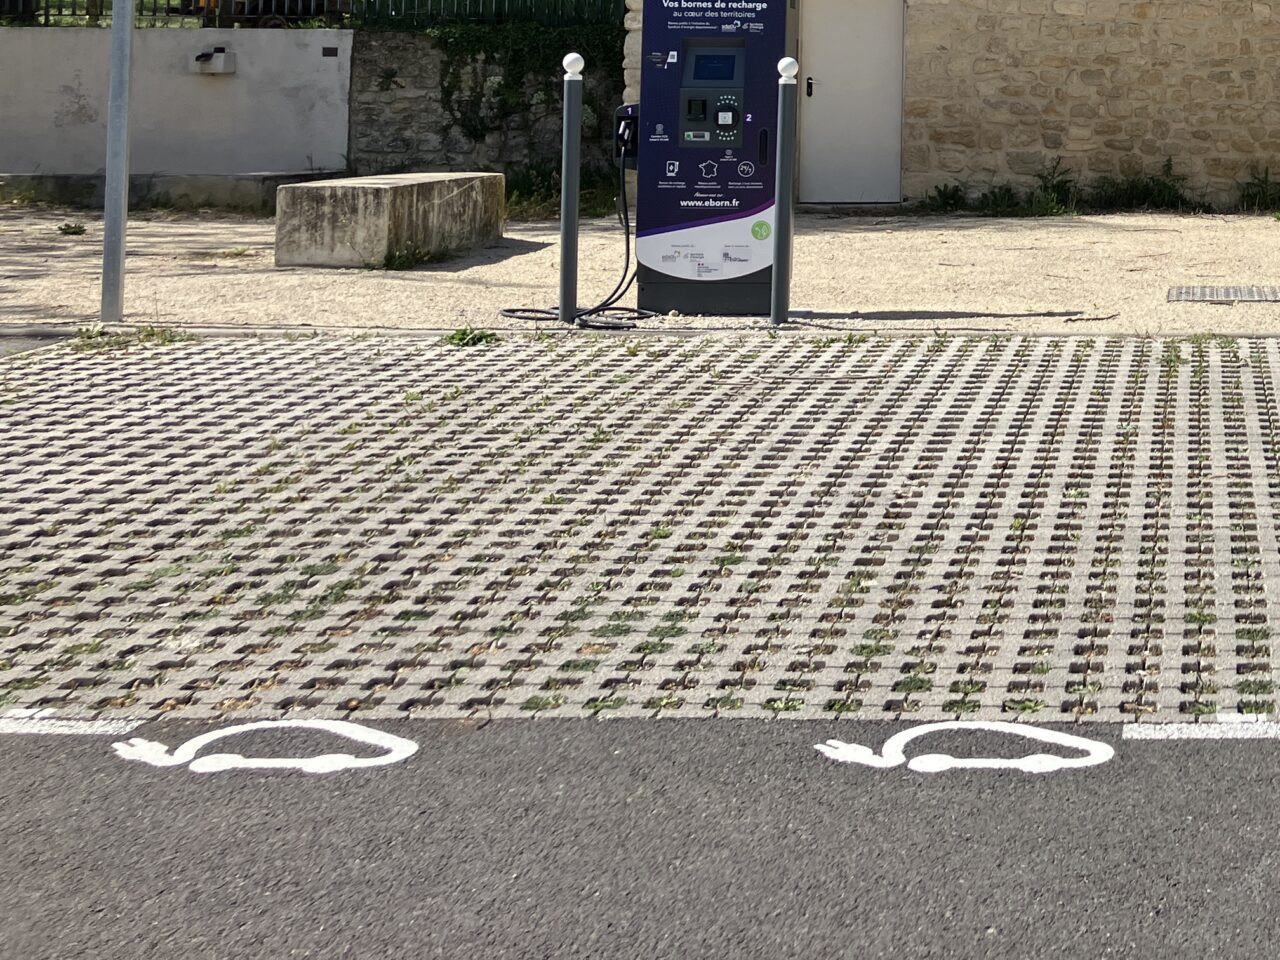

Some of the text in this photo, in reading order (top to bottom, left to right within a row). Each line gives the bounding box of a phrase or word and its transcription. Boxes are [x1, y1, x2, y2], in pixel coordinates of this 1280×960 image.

[662, 0, 768, 10] Vos bornes de recharge
[705, 10, 719, 18] des
[720, 10, 756, 18] territoires
[626, 107, 632, 115] 1
[746, 113, 752, 122] 2
[680, 198, 740, 207] www.eborn.fr
